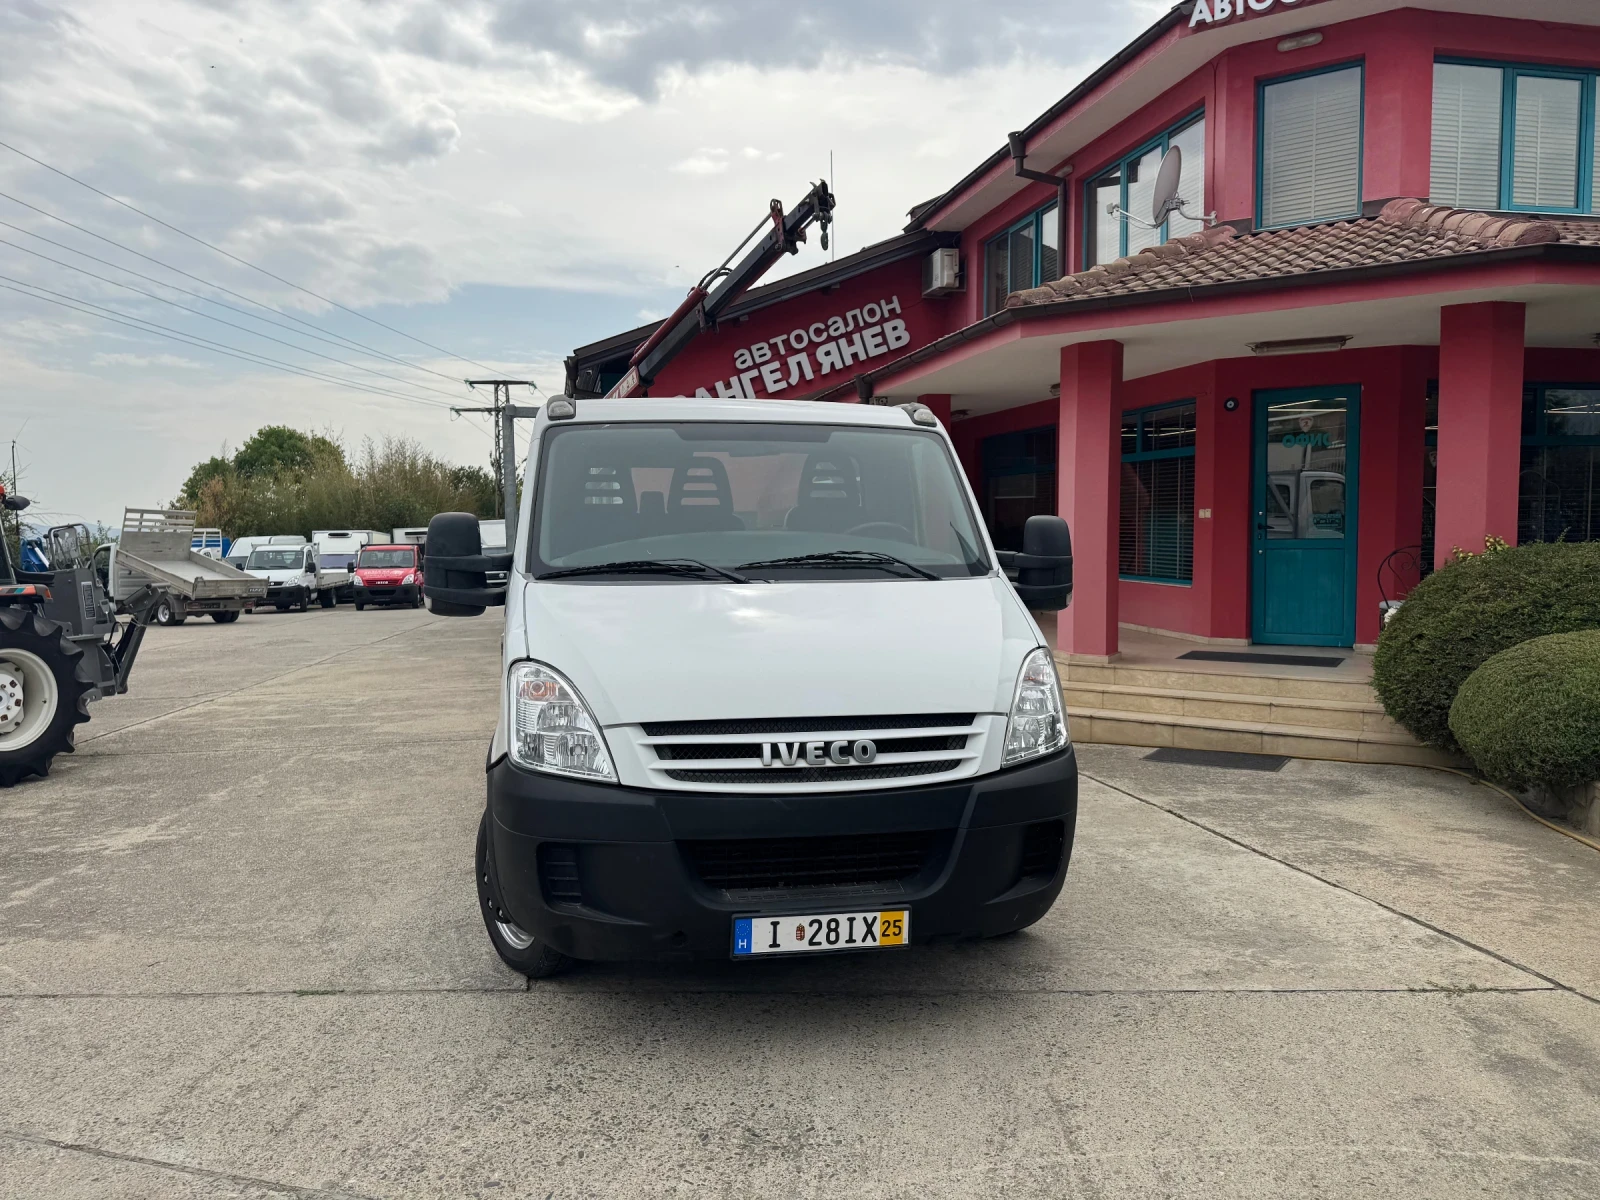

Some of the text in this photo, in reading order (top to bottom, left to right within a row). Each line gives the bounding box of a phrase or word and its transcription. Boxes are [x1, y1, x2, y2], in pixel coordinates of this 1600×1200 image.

[733, 296, 901, 369] автосалон
[816, 318, 910, 375] ЯНЕВ
[762, 740, 877, 766] IVECO
[738, 939, 747, 949] H
